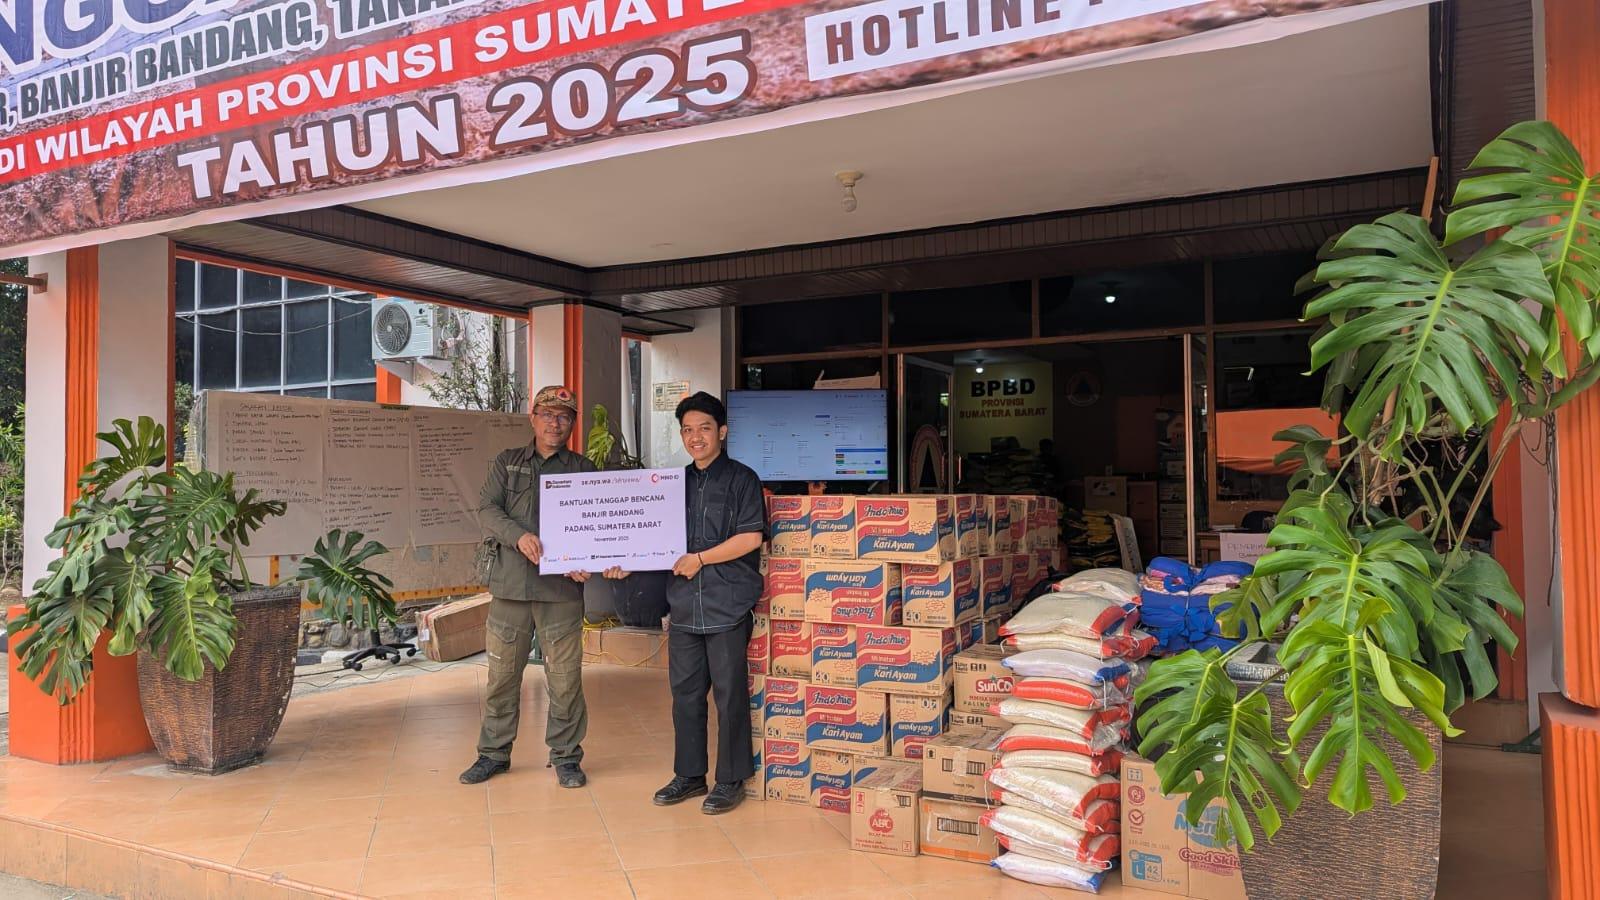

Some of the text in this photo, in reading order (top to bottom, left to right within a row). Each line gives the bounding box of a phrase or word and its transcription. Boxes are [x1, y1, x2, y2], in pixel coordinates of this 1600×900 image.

[825, 0, 1060, 65] HOTLINE
[20, 56, 127, 119] BANJIR
[136, 7, 323, 88] BANDANG,
[36, 98, 203, 164] WILAYAH
[217, 38, 453, 122] PROVINSI
[176, 35, 749, 199] TAHUN 2025
[971, 378, 1036, 397] BPBD
[981, 397, 1025, 407] PROVINSI
[960, 407, 1047, 418] SUMATERA BARAT
[559, 494, 665, 507] BANTUAN TANGGAP BENCANA
[582, 508, 644, 519] BANJIR BANDANG
[564, 520, 662, 533] PADANG, SUMATERA BARAT
[873, 539, 915, 551] Kari Ayam
[826, 572, 867, 584] Kari Ayam
[925, 589, 945, 598] Ayam
[819, 649, 853, 659] Kari Ayam
[874, 668, 917, 681] Kari Ayam
[977, 678, 1012, 693] SunCo
[822, 727, 863, 741] Kari Ayam
[872, 817, 891, 828] ABC
[1181, 849, 1212, 863] Good
[1146, 864, 1159, 875] 42
